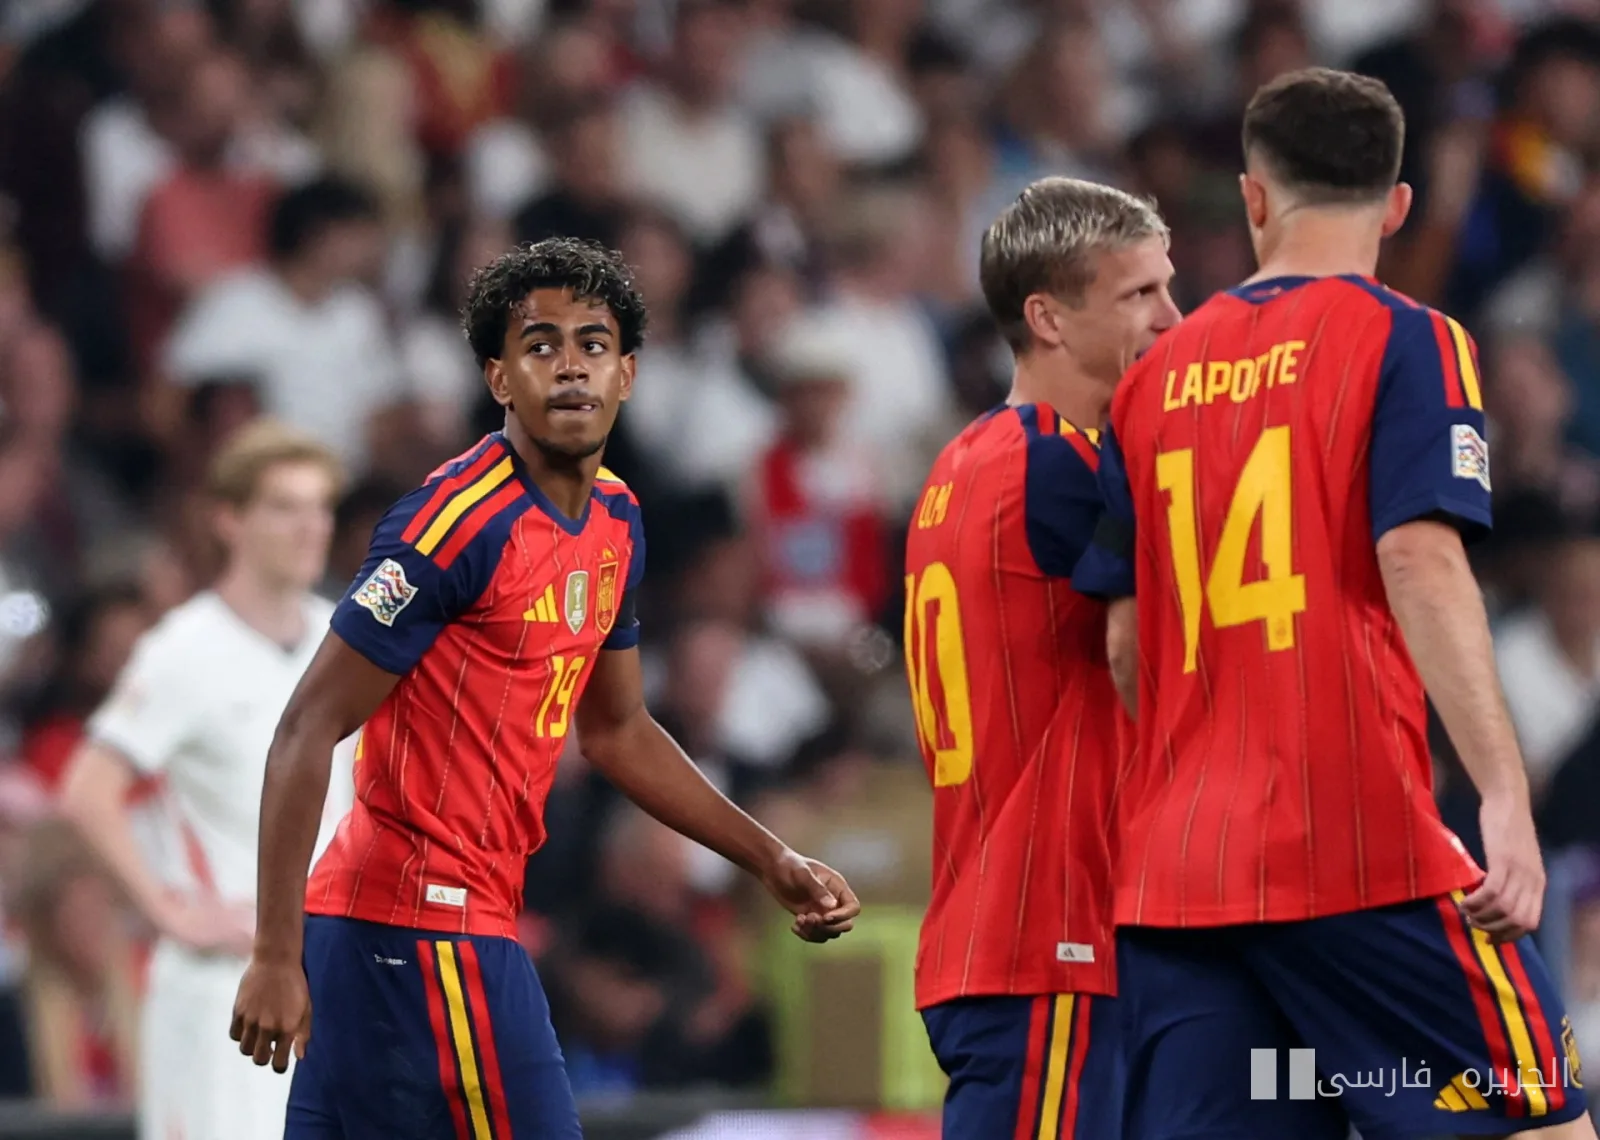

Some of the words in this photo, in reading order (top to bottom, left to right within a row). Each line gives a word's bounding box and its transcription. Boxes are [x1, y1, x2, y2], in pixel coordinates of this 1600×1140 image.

[1156, 425, 1307, 674] 14
[535, 655, 586, 739] 19
[904, 561, 974, 788] 10
